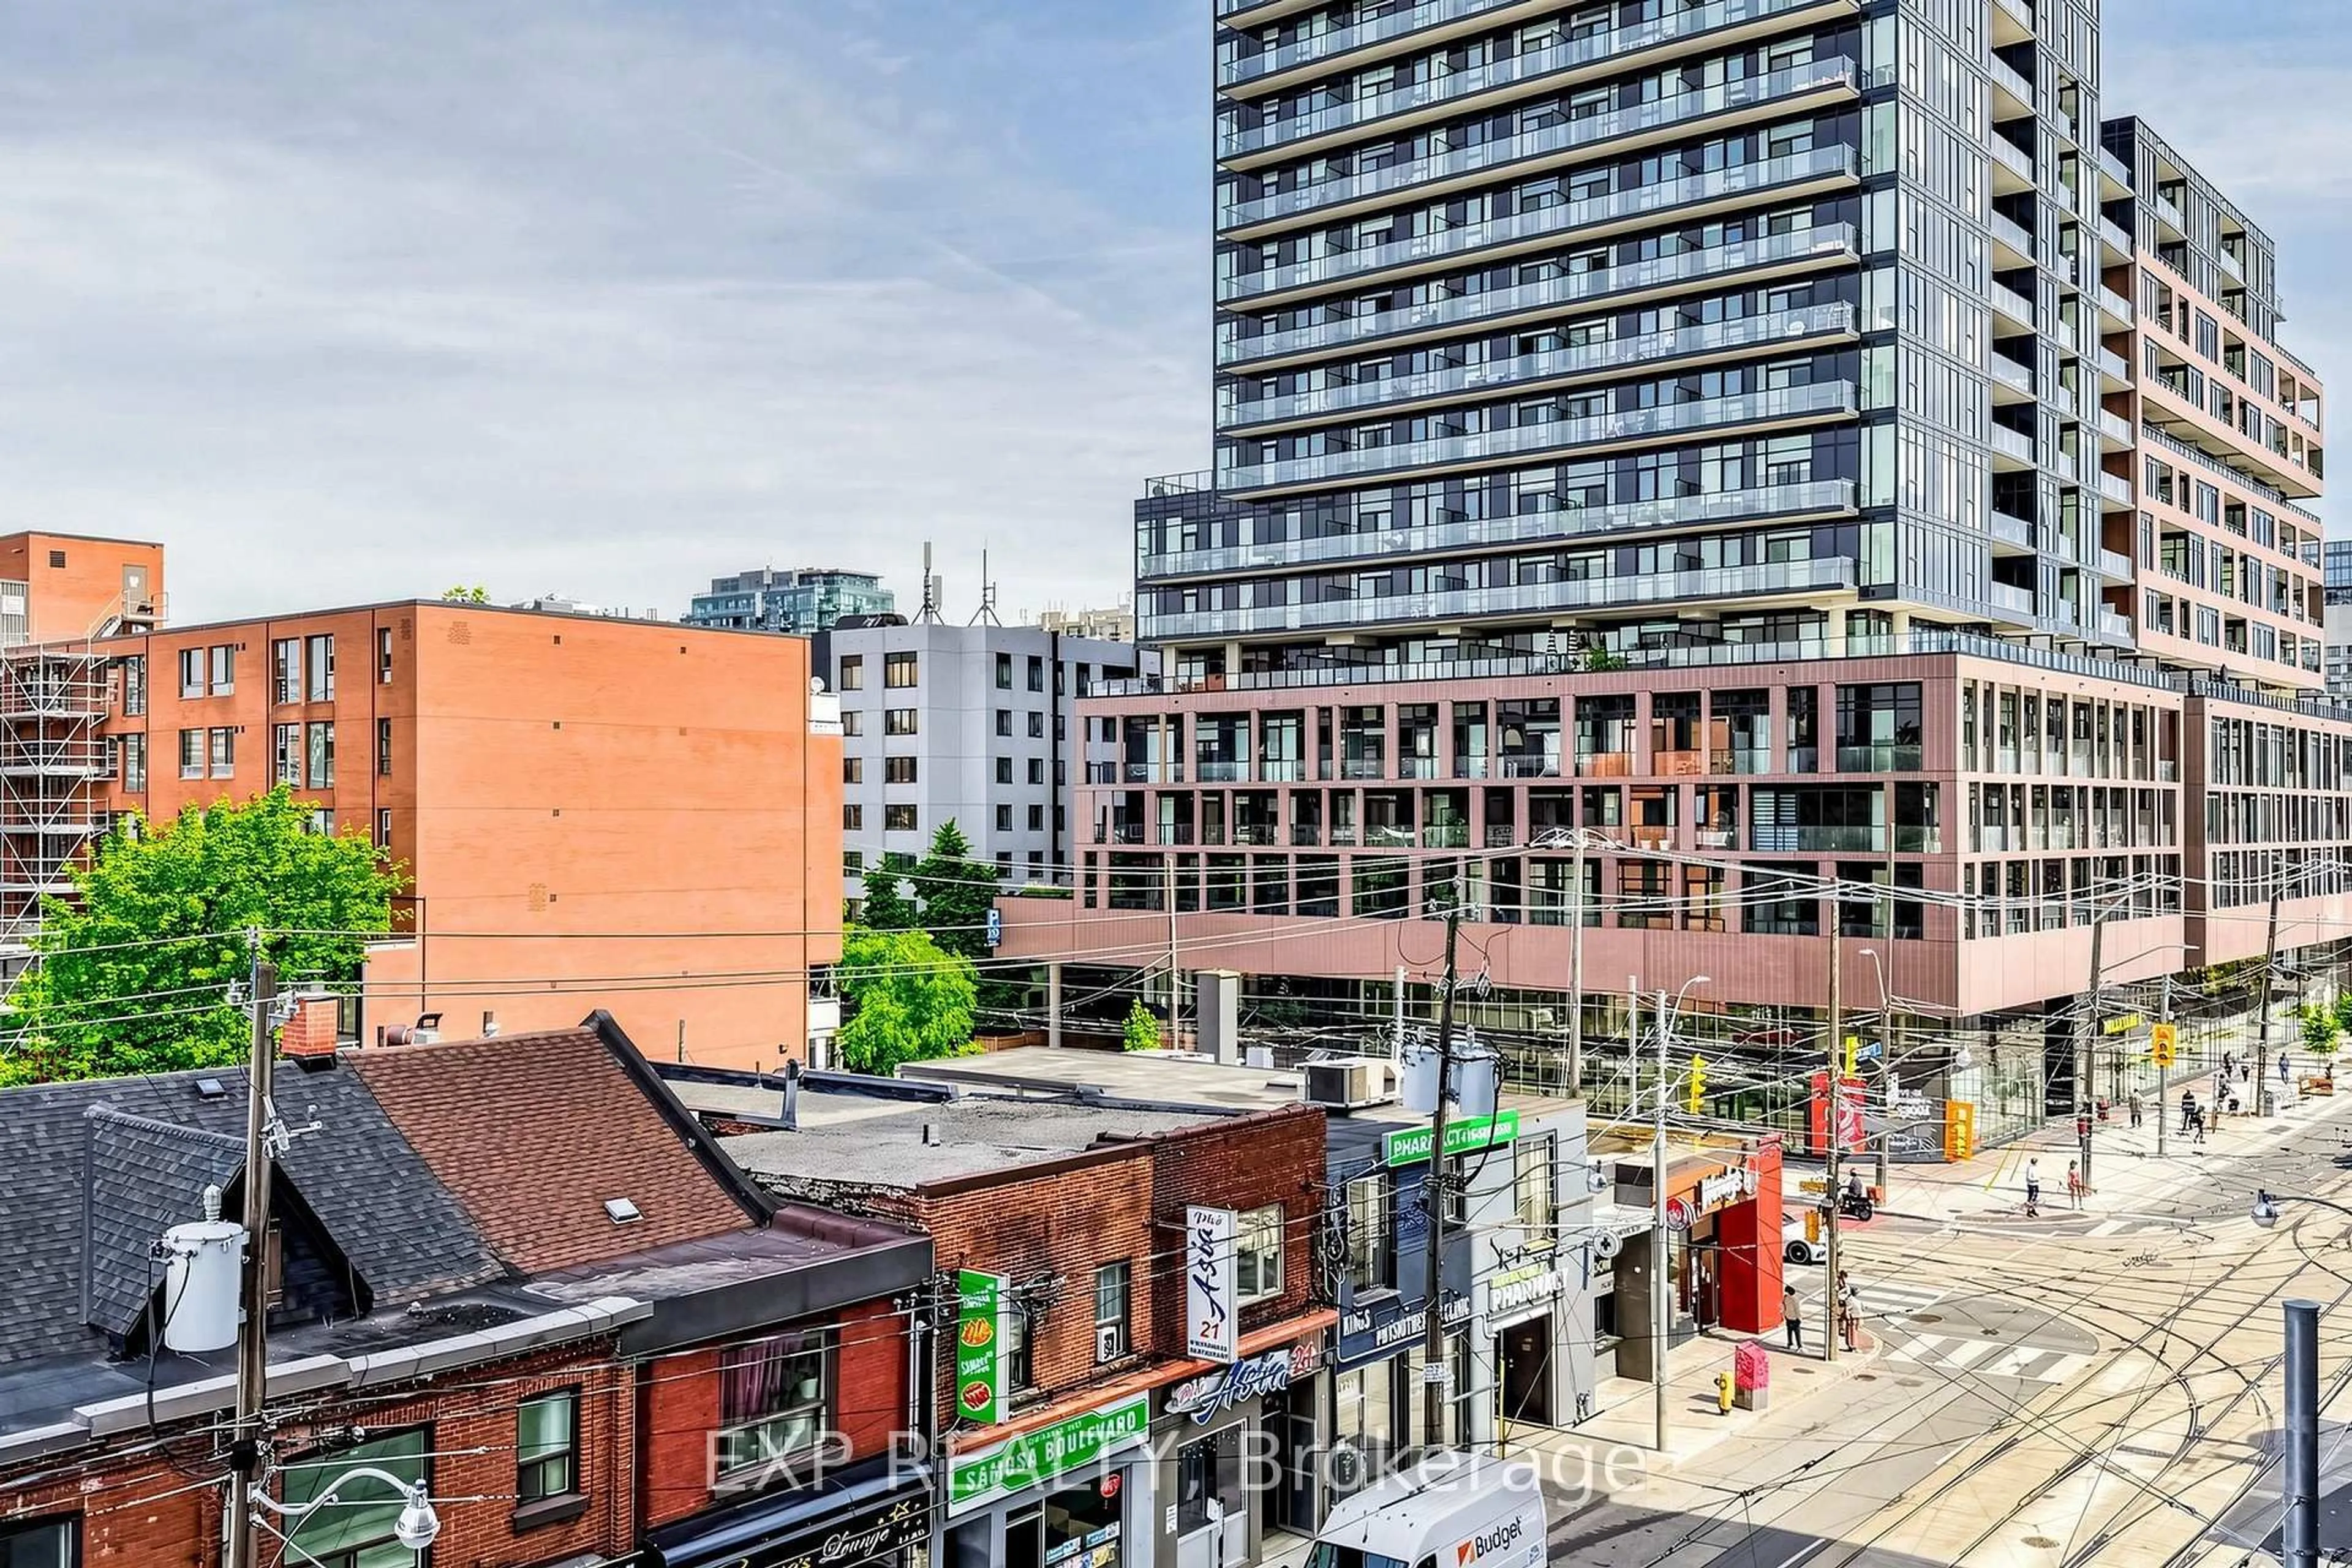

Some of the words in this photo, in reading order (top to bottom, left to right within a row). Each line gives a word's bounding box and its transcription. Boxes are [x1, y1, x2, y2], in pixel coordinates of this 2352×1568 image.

[1191, 1227, 1226, 1322] Asia
[1200, 1321, 1221, 1340] 21
[965, 1447, 1037, 1491] SAMOSA
[1045, 1411, 1136, 1462] BOULEVARD
[819, 1529, 889, 1564] Lounge
[1474, 1515, 1523, 1558] Budget
